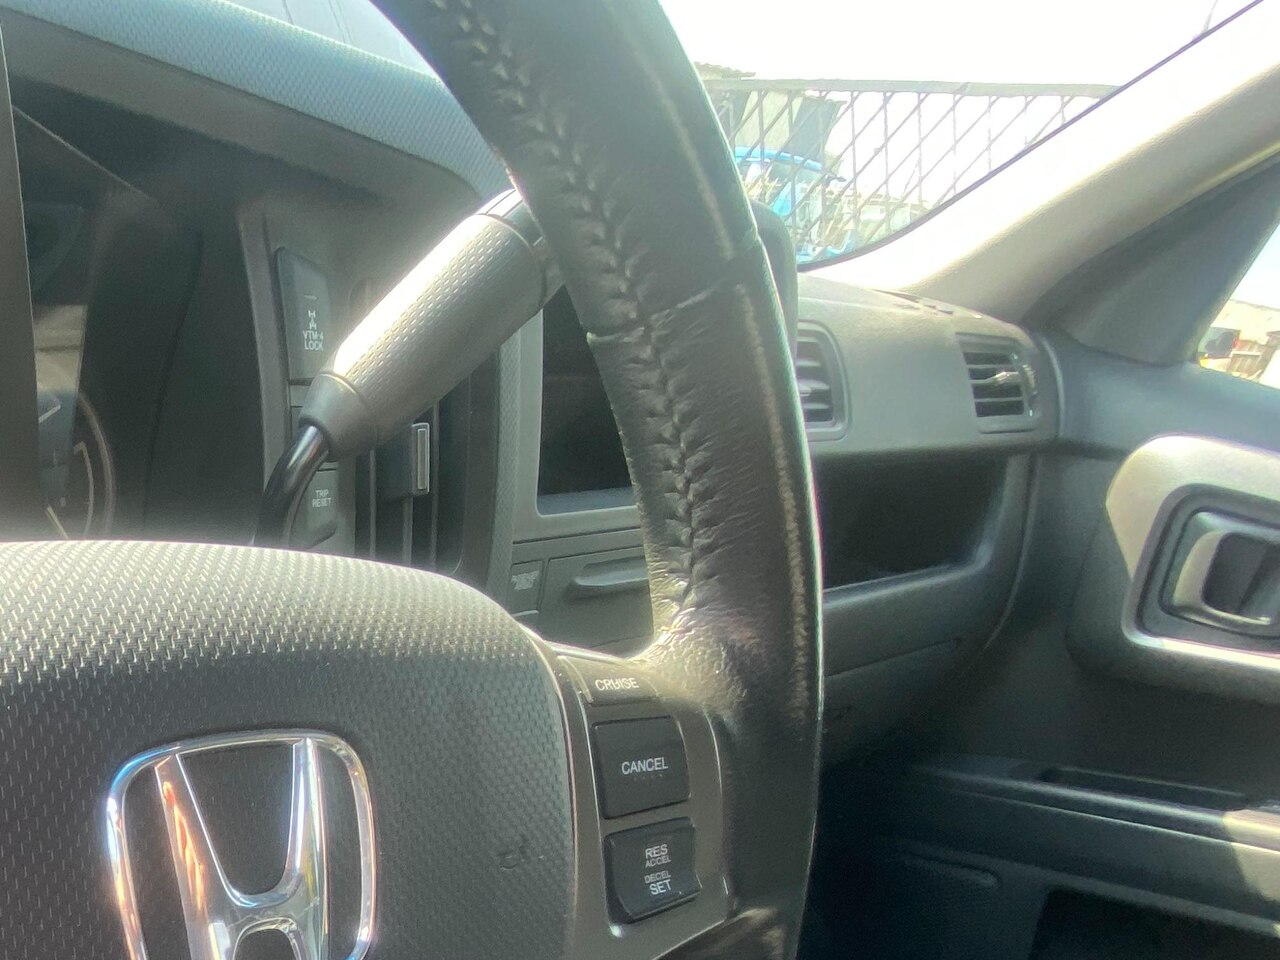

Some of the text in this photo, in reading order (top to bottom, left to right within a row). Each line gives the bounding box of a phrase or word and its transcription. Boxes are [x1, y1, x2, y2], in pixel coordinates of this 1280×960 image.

[304, 340, 324, 351] LOCK
[594, 677, 640, 692] CRUISE
[621, 756, 669, 776] CANCEL
[645, 843, 669, 859] RES
[644, 855, 672, 869] ACCEL
[644, 870, 672, 884] DECEL
[649, 879, 672, 896] SET
